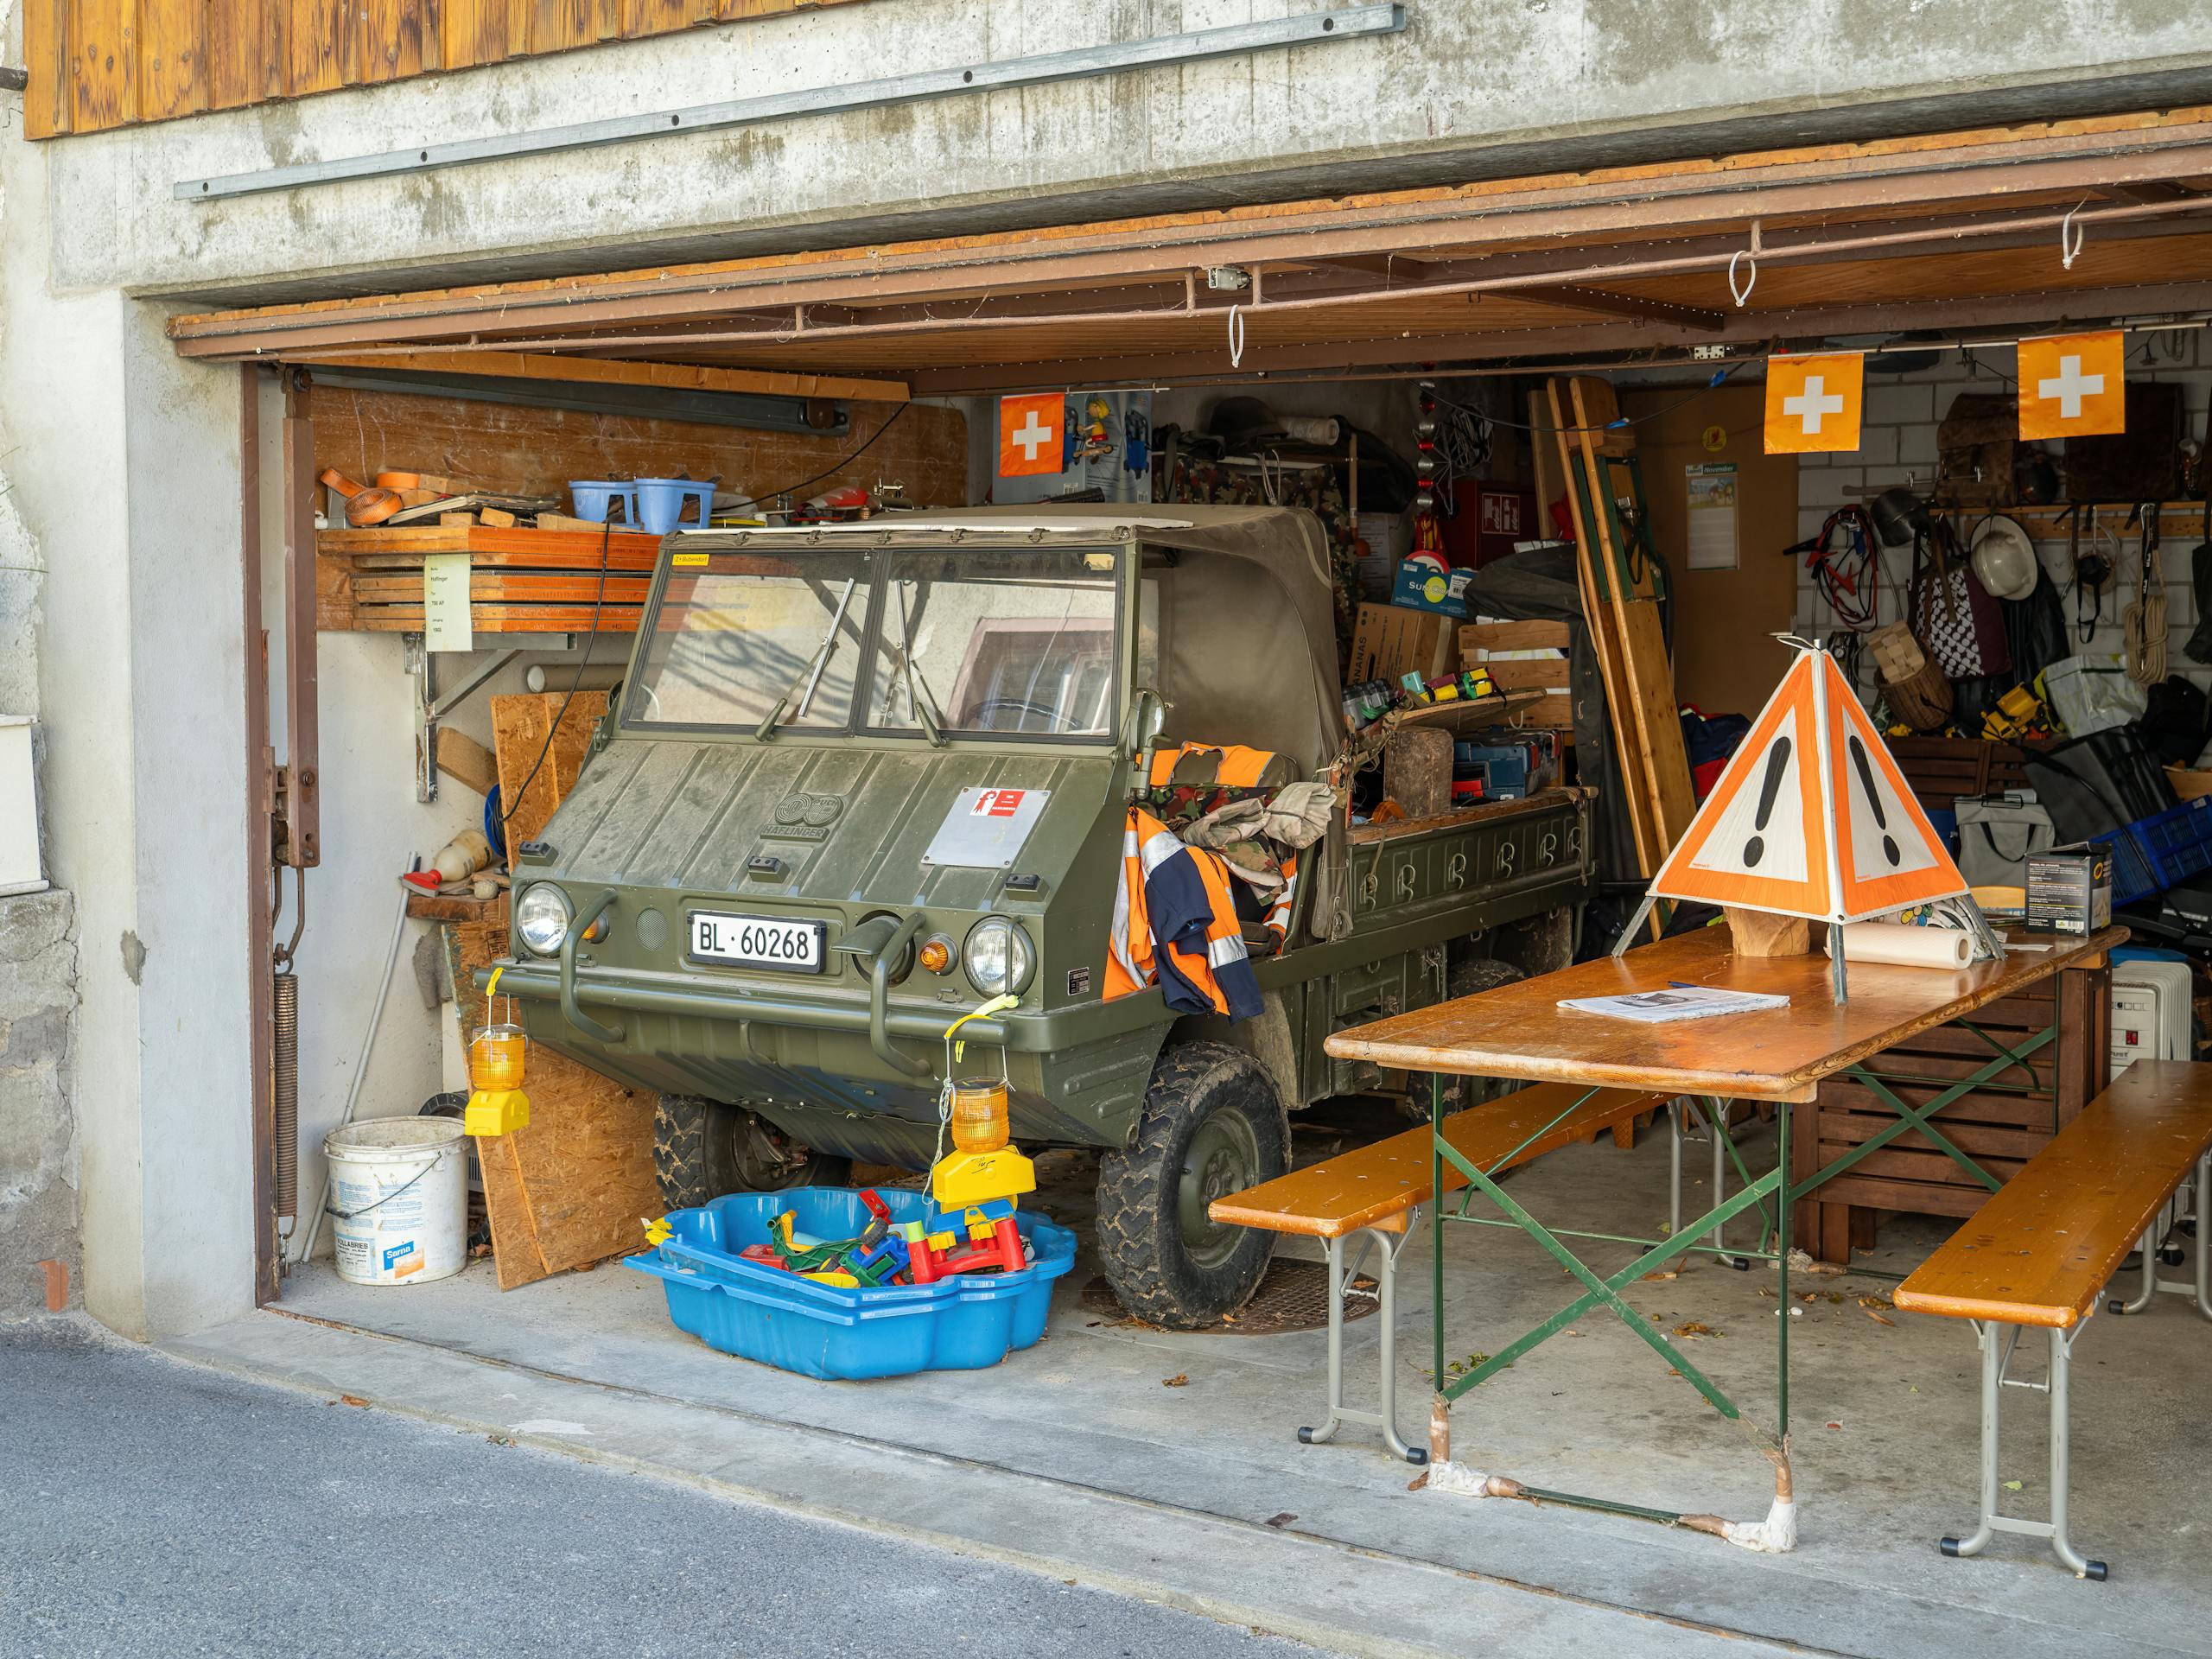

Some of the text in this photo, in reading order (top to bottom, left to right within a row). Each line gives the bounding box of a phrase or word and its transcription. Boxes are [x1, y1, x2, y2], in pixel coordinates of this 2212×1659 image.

[1704, 465, 1734, 474] November
[761, 826, 824, 837] HAFLINGER
[701, 921, 725, 952] BL
[741, 925, 809, 960] 60268
[386, 1245, 411, 1259] Sarna
